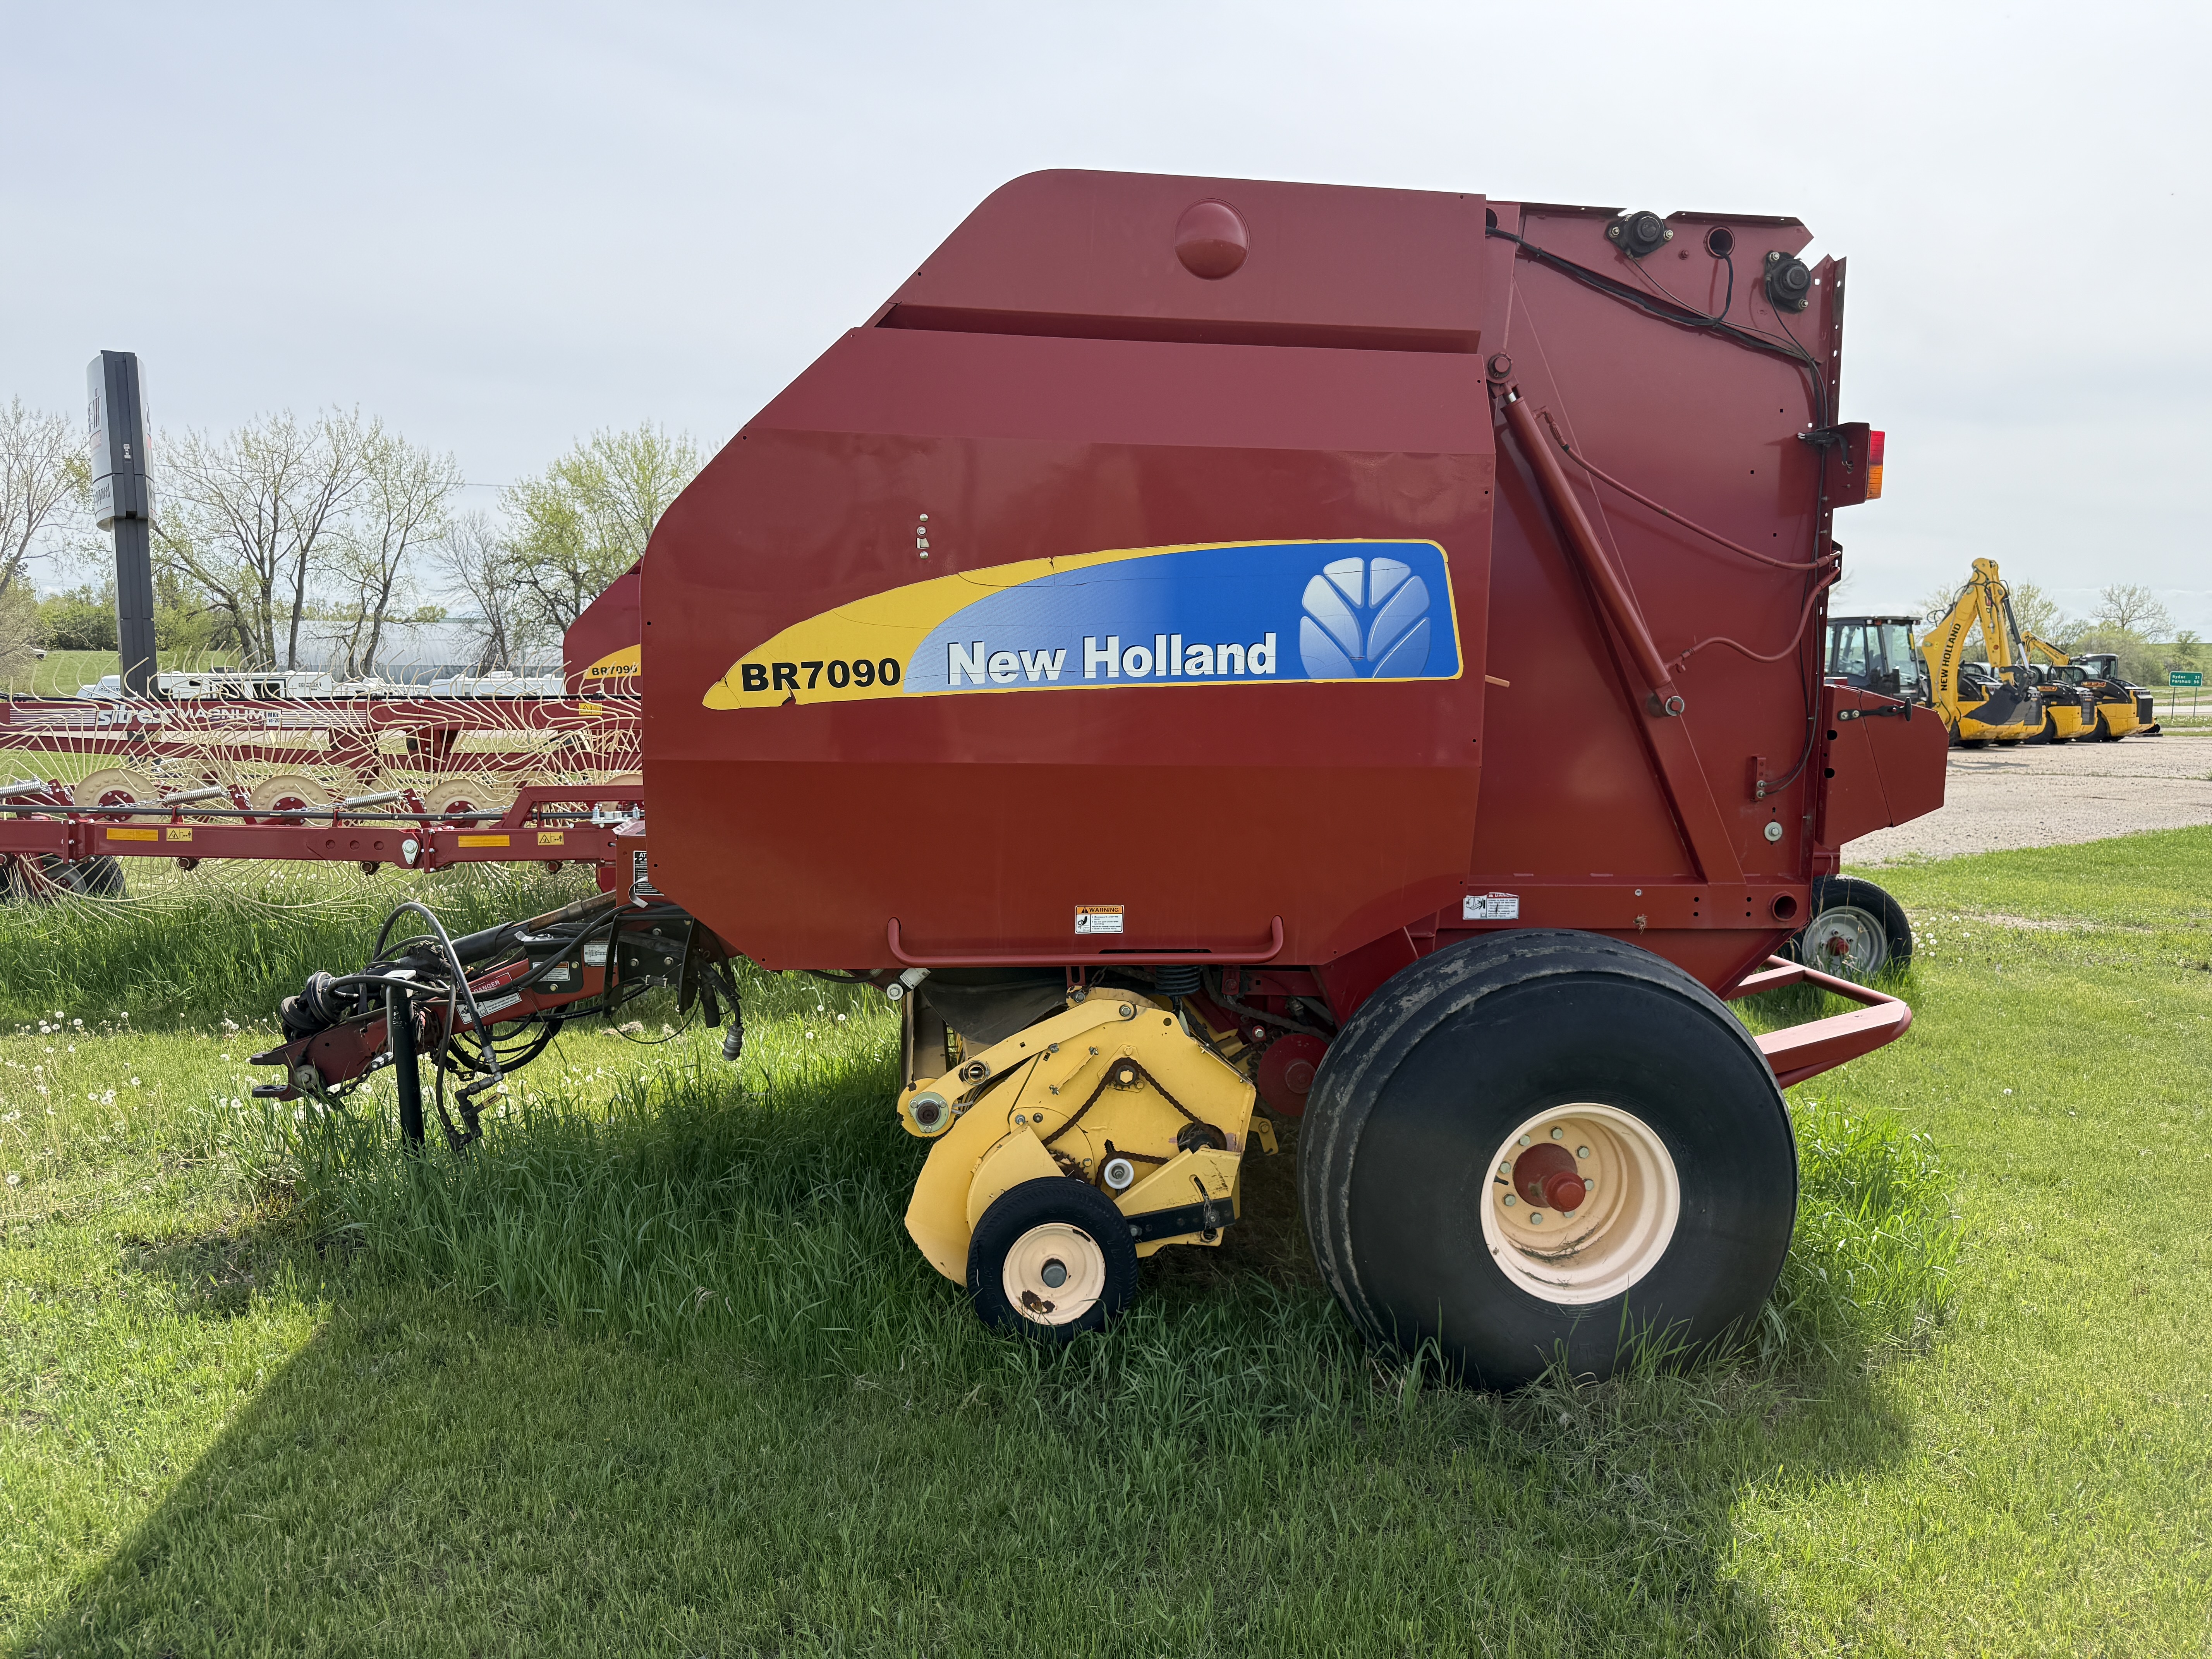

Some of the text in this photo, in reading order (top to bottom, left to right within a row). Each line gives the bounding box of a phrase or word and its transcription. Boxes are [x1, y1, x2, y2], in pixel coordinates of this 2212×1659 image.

[592, 665, 637, 675] BR7090
[948, 632, 1276, 686] New Holland
[1940, 623, 1961, 691] NEW HOLLAND
[742, 658, 900, 692] BR7090
[98, 704, 265, 726] sitrex MAGNUM
